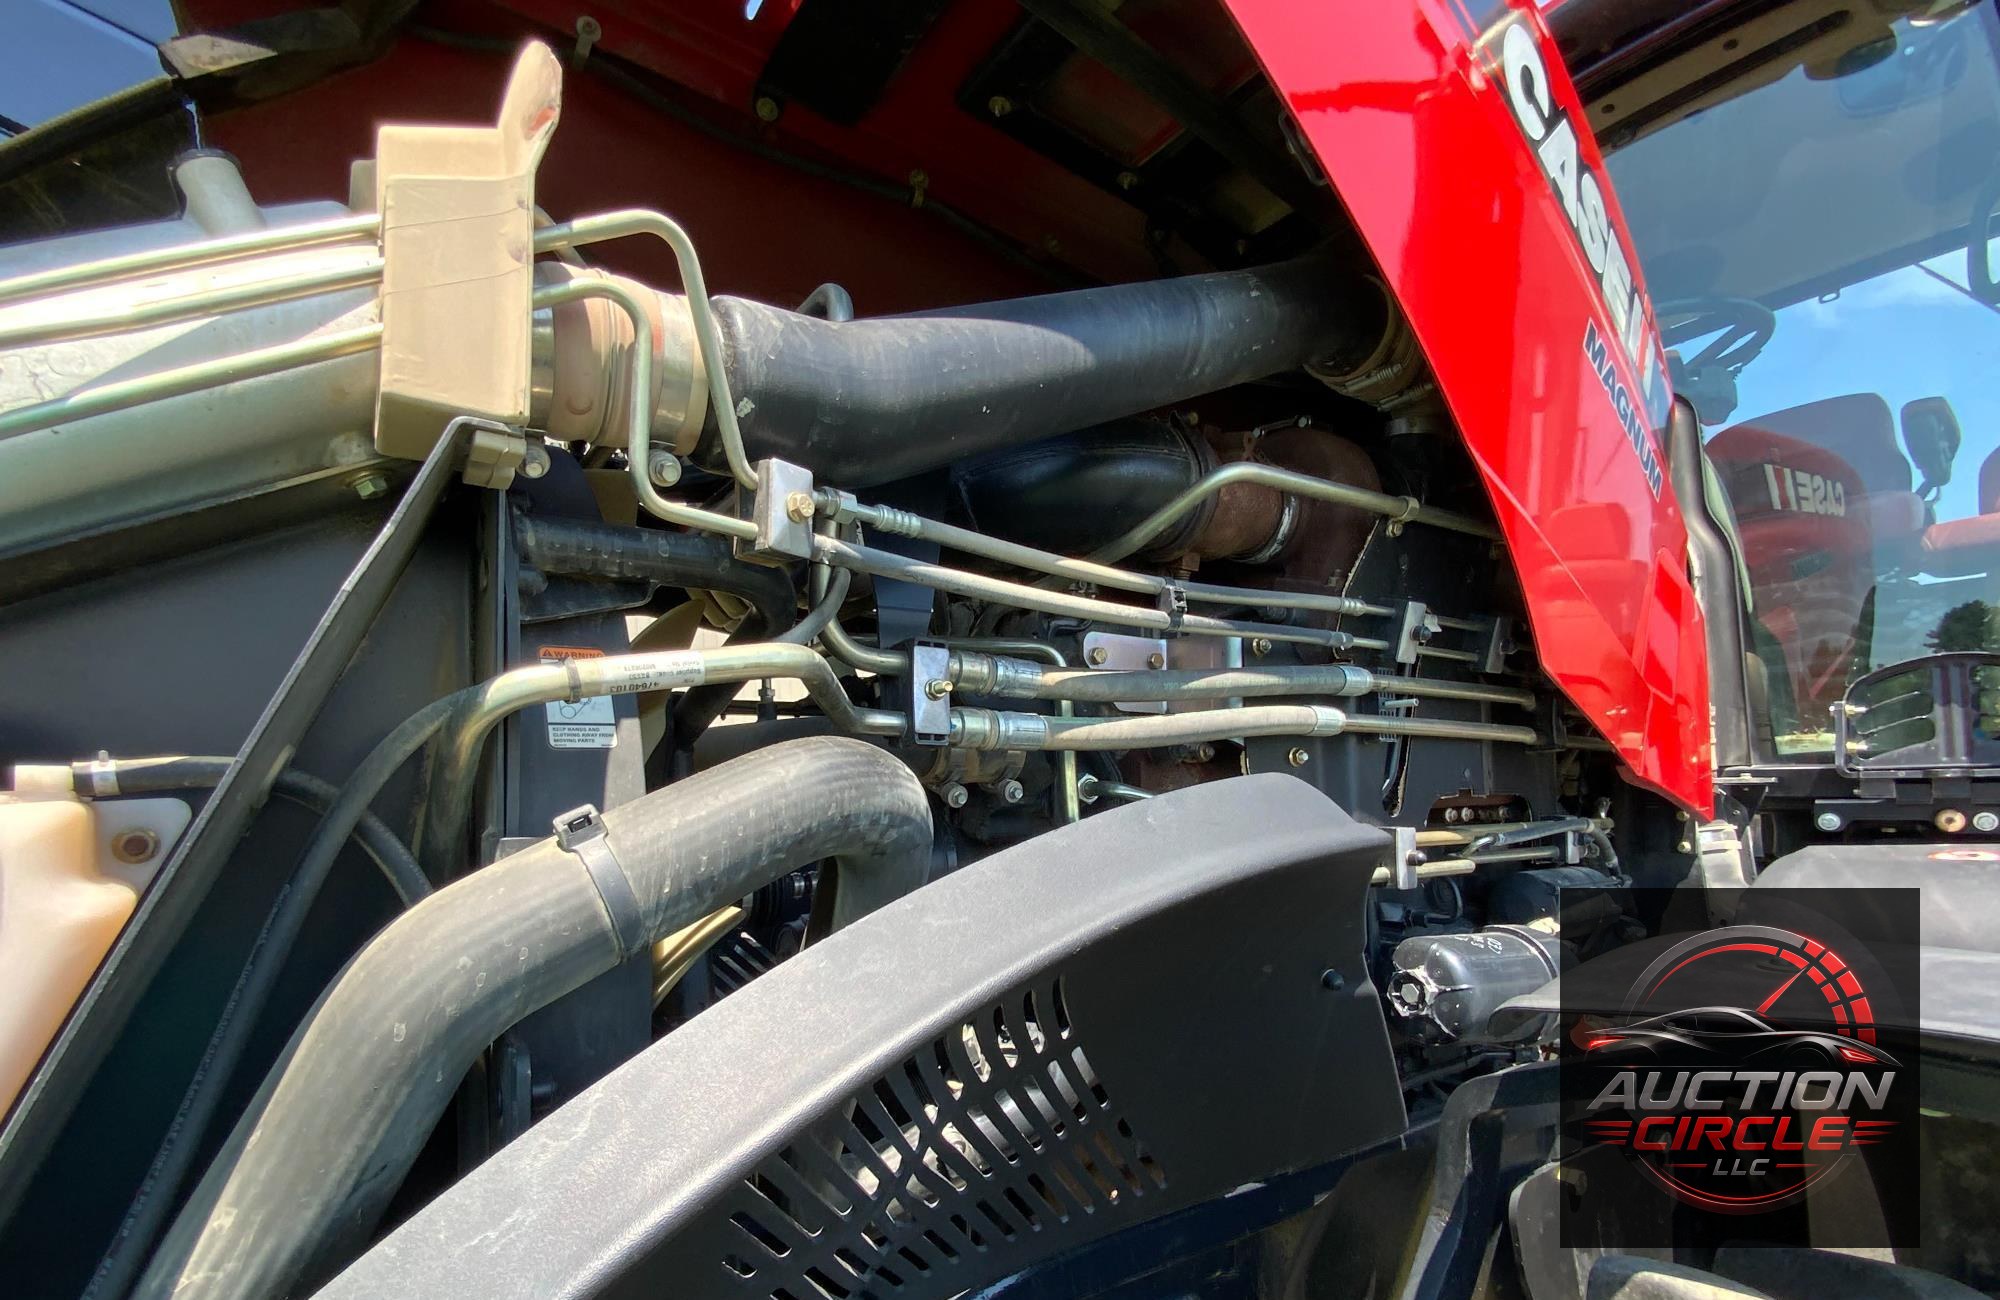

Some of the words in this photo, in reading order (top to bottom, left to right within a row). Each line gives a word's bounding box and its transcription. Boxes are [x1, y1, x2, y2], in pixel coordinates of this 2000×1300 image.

[1503, 24, 1631, 333] CASE
[1583, 316, 1664, 503] MAGNUM
[553, 650, 603, 660] WARNING
